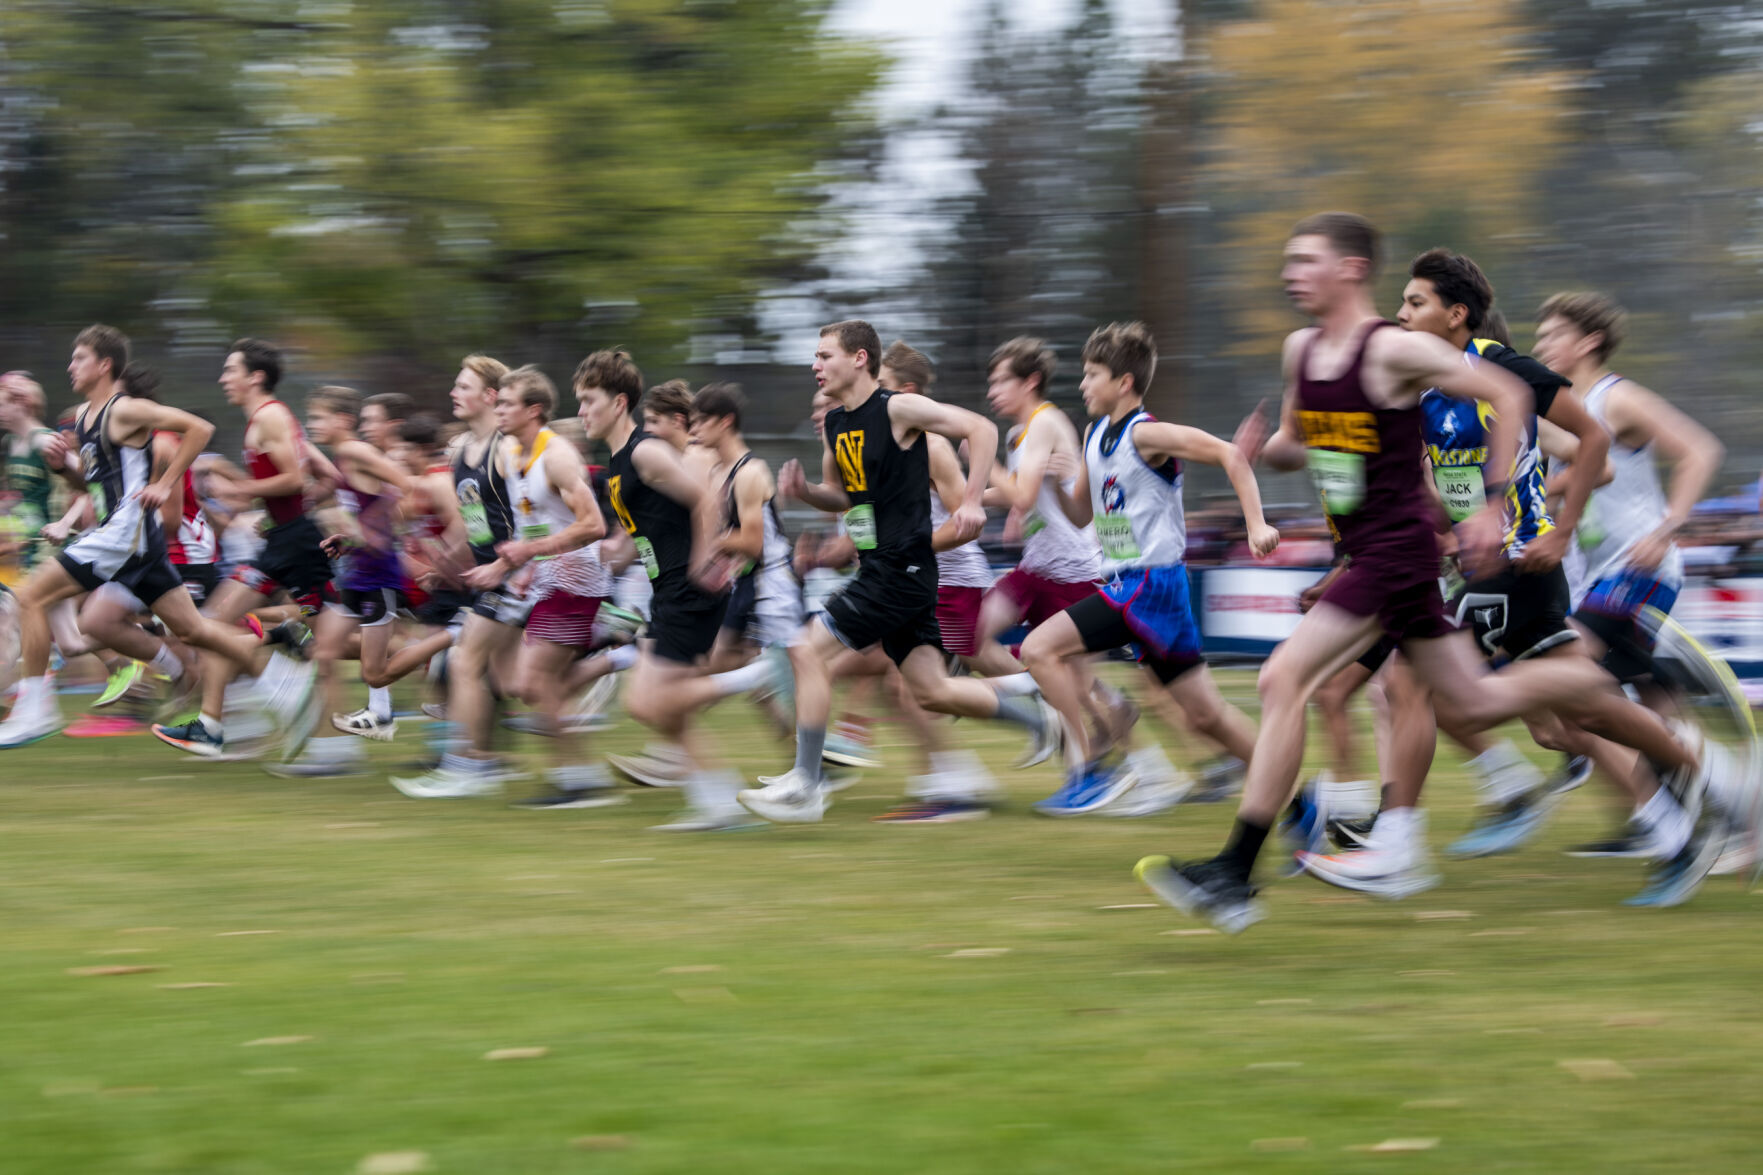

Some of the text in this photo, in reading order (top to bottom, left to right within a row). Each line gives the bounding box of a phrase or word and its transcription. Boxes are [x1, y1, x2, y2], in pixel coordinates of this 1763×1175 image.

[835, 430, 868, 492] N
[1445, 483, 1472, 494] JACK
[1449, 499, 1470, 509] C1630
